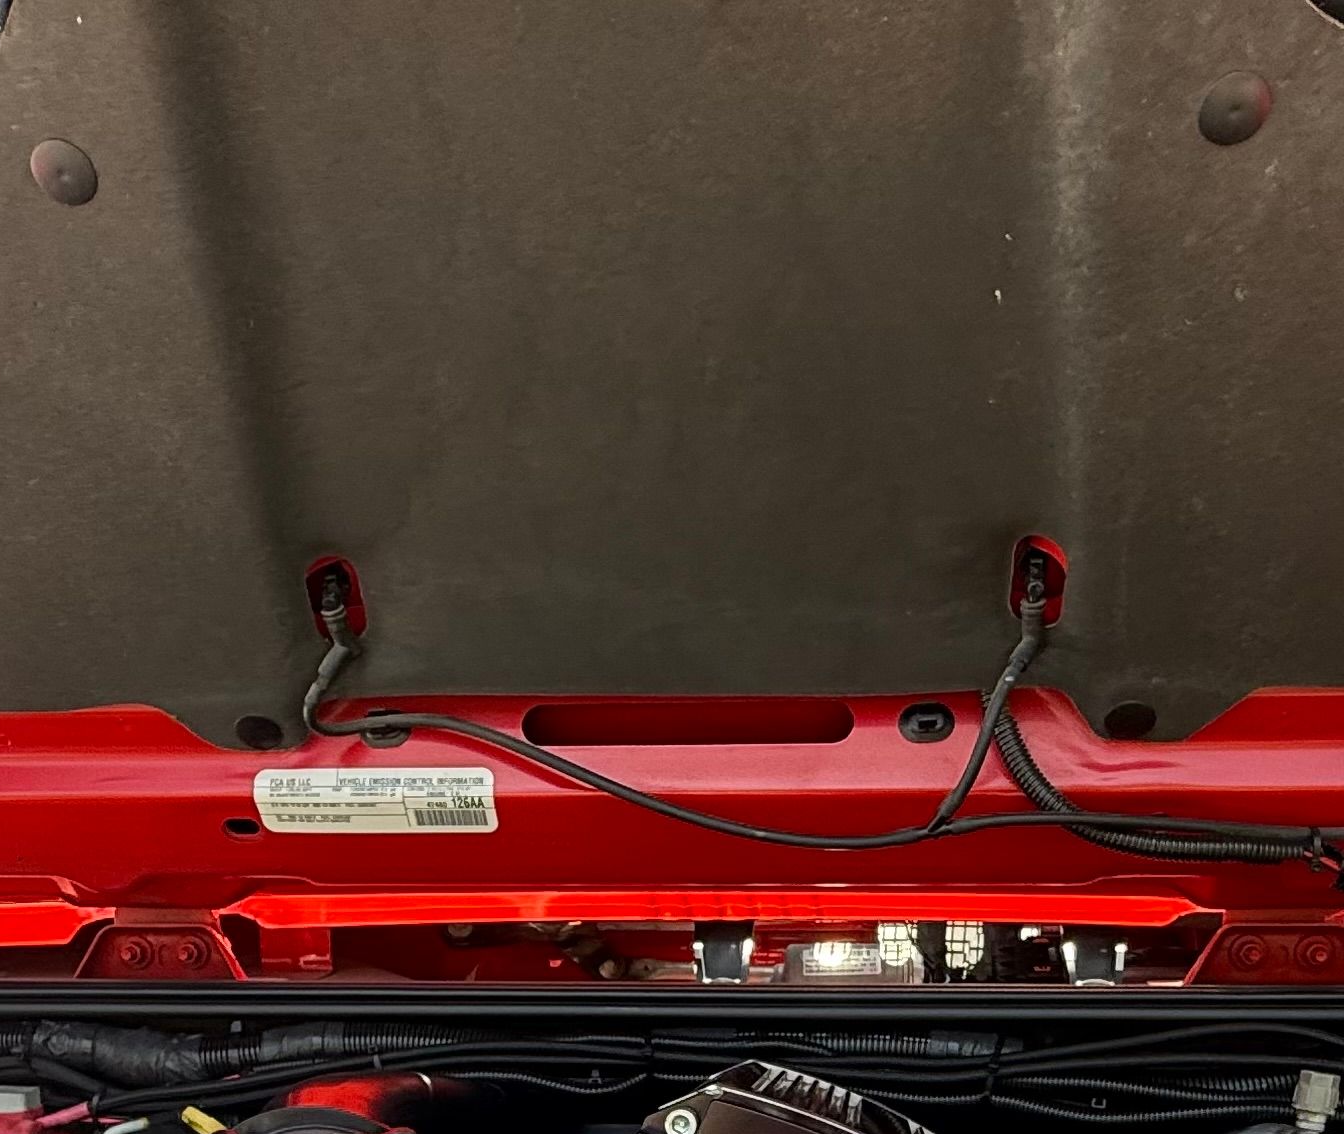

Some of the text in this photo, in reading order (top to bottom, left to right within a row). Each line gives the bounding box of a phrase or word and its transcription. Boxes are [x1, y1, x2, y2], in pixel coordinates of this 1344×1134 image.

[339, 777, 484, 787] VEHICLE EMISSION CONTROL INFORMATION
[451, 796, 485, 809] 126AA
